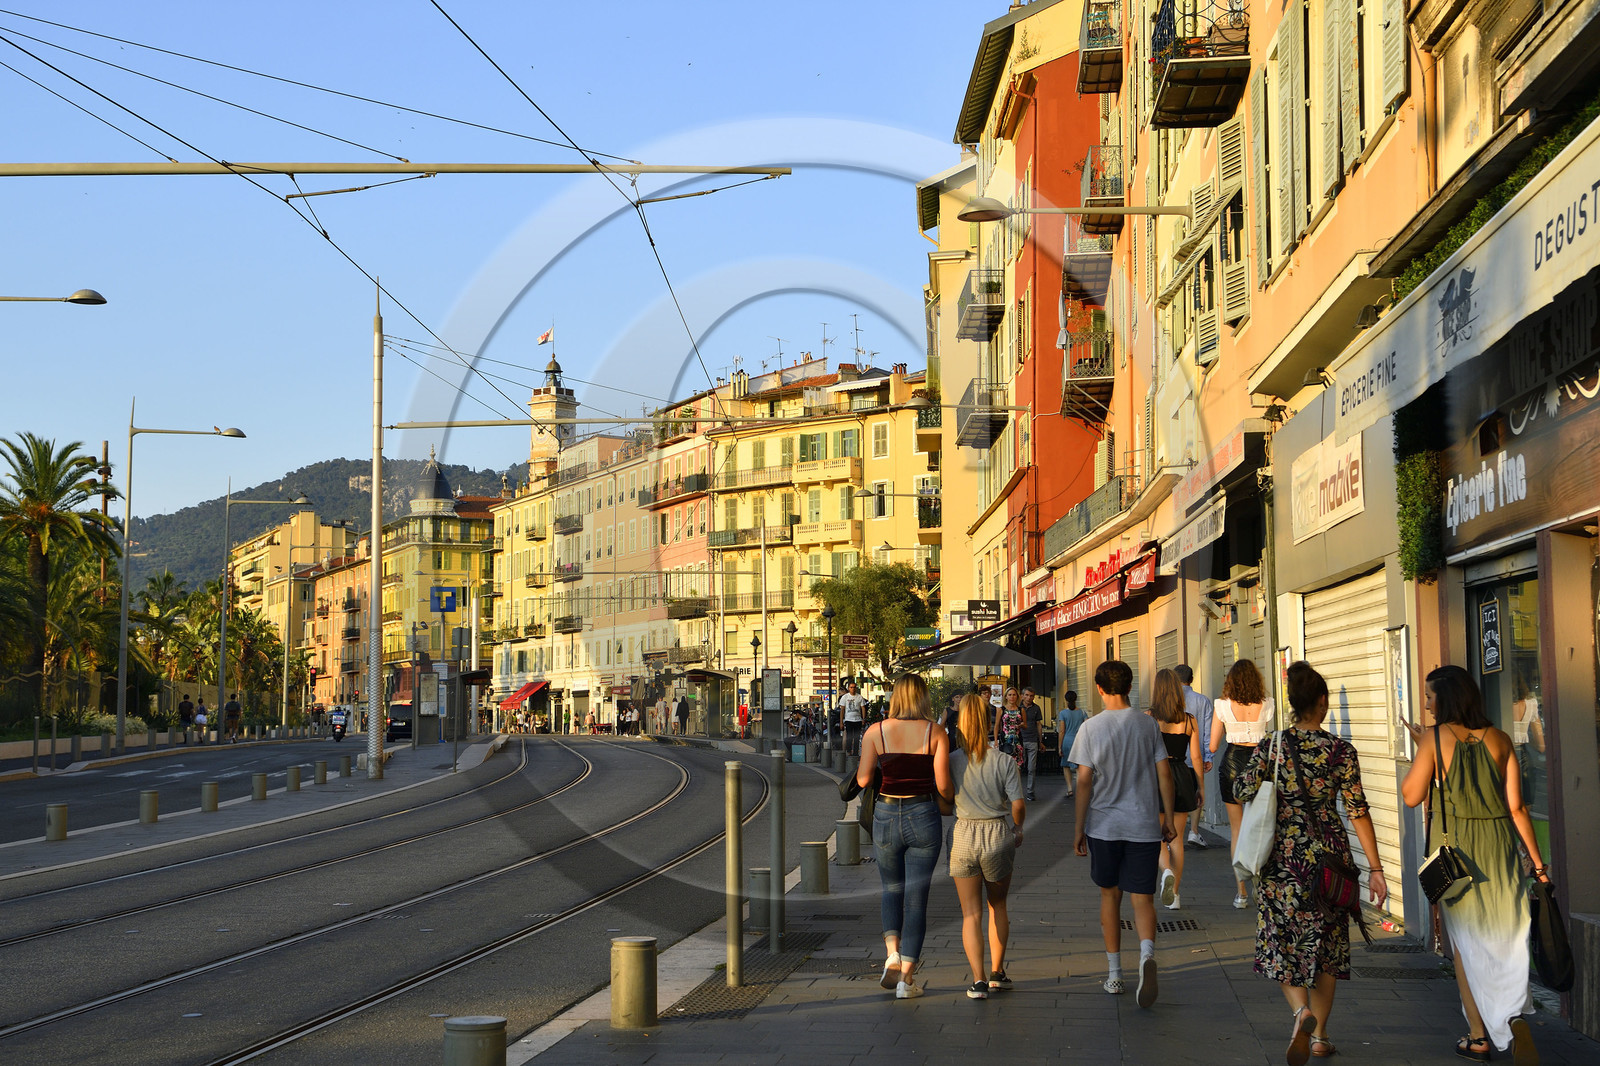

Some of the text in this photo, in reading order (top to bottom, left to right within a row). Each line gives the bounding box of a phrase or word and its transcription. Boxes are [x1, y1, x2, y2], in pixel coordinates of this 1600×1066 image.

[1341, 350, 1396, 417] EPICERIE FINE
[1319, 452, 1360, 517] mobile
[1446, 460, 1495, 537] Epicerie
[906, 633, 935, 641] SUBWAY
[1484, 609, 1496, 623] ICI
